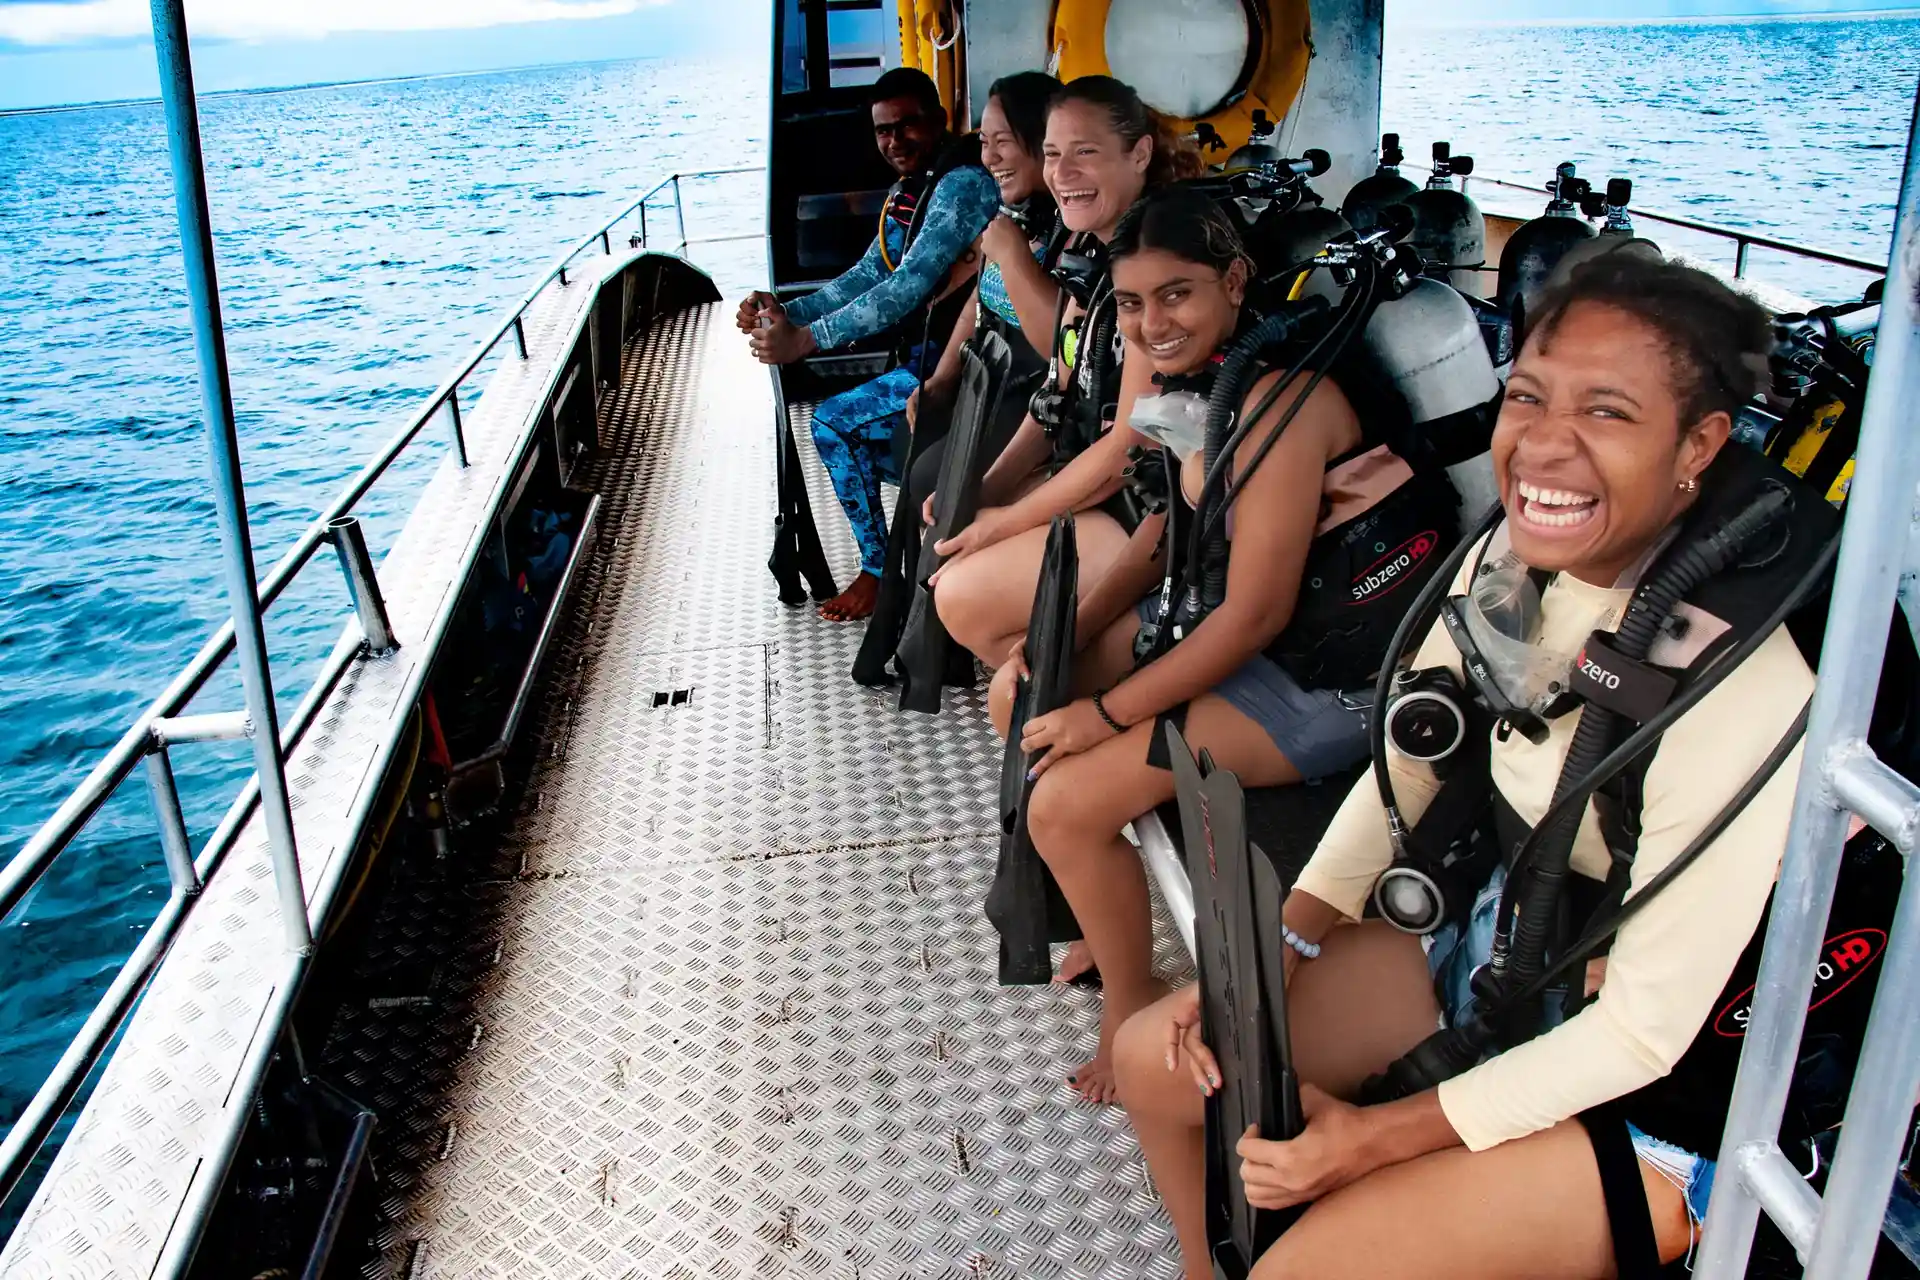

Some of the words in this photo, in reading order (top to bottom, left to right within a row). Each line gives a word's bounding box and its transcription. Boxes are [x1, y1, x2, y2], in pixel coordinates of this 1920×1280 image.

[1352, 554, 1410, 600] subzero
[1407, 537, 1430, 560] HD
[1831, 938, 1870, 971] HD
